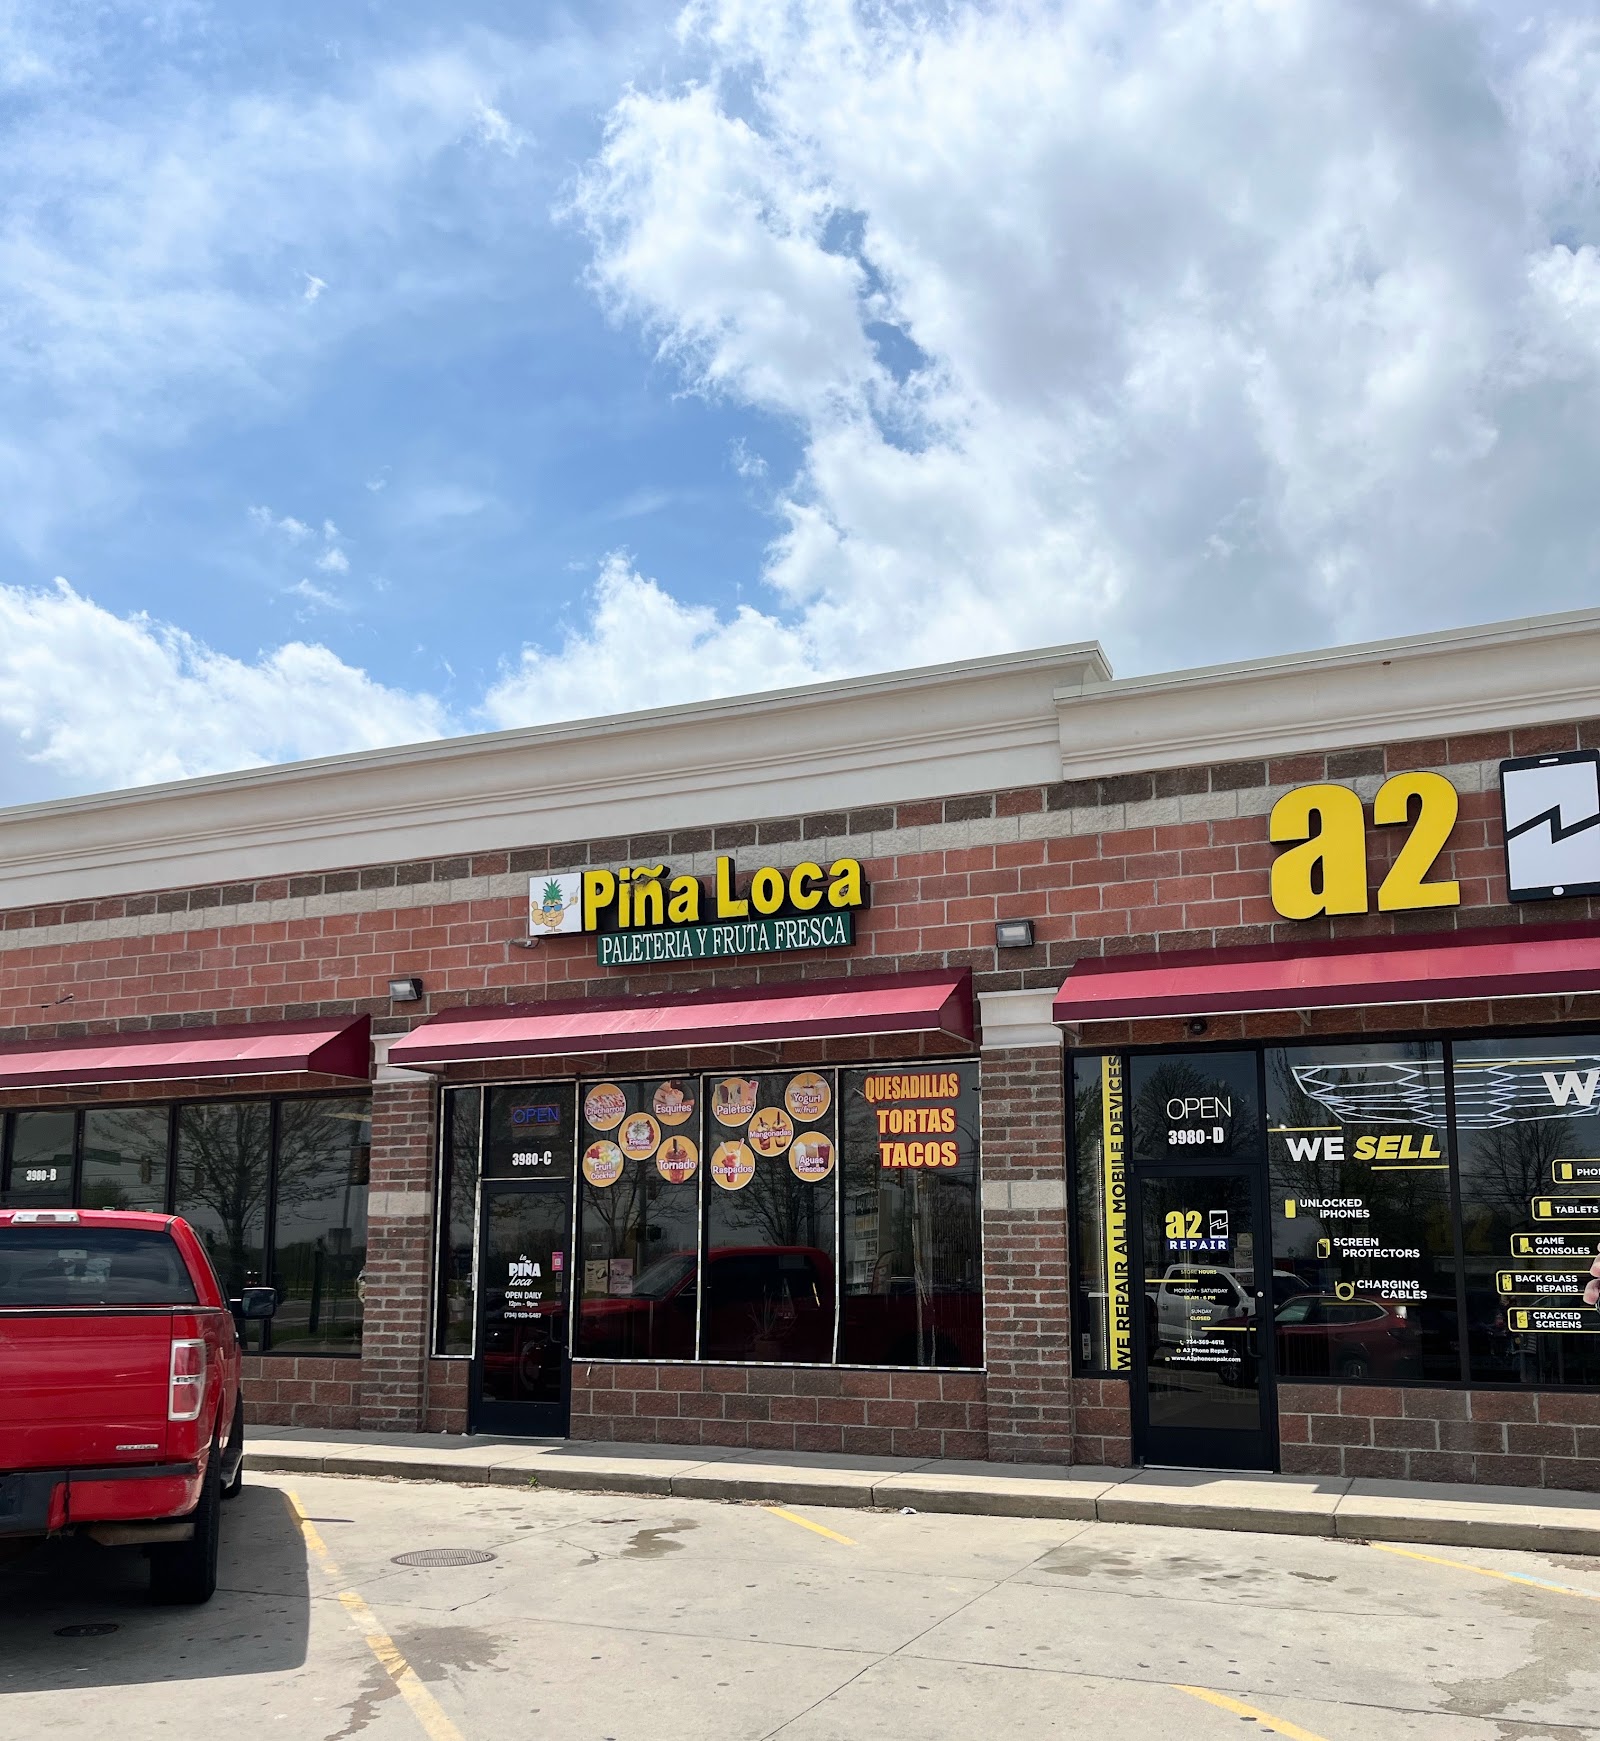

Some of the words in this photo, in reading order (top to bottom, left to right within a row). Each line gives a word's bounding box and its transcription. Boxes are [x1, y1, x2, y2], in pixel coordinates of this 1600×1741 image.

[1270, 771, 1460, 919] a2
[583, 864, 699, 931] Piña
[716, 856, 862, 919] Loca
[602, 933, 690, 964] PALETERIA
[698, 929, 711, 955] Y
[713, 923, 769, 953] FRUTA
[775, 915, 846, 950] FRESCA
[865, 1073, 959, 1102] QUESADILLAS
[793, 1093, 821, 1104] Yogurt
[1108, 1056, 1124, 1136] DEVICES
[655, 1104, 692, 1115] Esquites
[717, 1104, 752, 1116] Paletas
[1166, 1096, 1231, 1120] OPEN
[513, 1106, 559, 1123] OPEN
[877, 1108, 955, 1133] TORTAS
[750, 1129, 792, 1139] Mangonadas
[1168, 1126, 1224, 1145] 3980-D
[1286, 1137, 1345, 1161] WE
[1353, 1134, 1441, 1160] SELL
[512, 1150, 552, 1166] 3980-C
[880, 1142, 957, 1166] TACOS
[658, 1159, 697, 1170] Tornado
[800, 1155, 824, 1166] Aguas
[594, 1162, 612, 1171] Fruit
[713, 1163, 753, 1176] Raspados
[798, 1165, 825, 1173] Frescas
[26, 1168, 56, 1181] 3980-B
[591, 1171, 616, 1180] Cocktail
[1111, 1142, 1127, 1214] MOBILE
[1299, 1199, 1362, 1208] UNLOCKED
[1319, 1209, 1370, 1218] iPHONES
[1555, 1205, 1599, 1214] TABLETS
[1165, 1210, 1202, 1239] a2
[1113, 1219, 1128, 1257] ALL
[1333, 1238, 1379, 1246] SCREEN
[1535, 1237, 1564, 1245] GAME
[1169, 1240, 1226, 1250] REPAIR
[1535, 1246, 1590, 1255] CONSOLES
[1342, 1248, 1420, 1257] PROTECTORS
[508, 1260, 541, 1277] PIÑA
[509, 1274, 533, 1286] Loca
[1356, 1280, 1420, 1289] CHARGING
[1545, 1275, 1578, 1283] GLASS
[1381, 1290, 1428, 1299] CABLES
[1536, 1285, 1578, 1293] REPAIRS
[505, 1291, 523, 1299] OPEN
[524, 1291, 542, 1299] DAILY
[1115, 1261, 1130, 1330] REPAIR
[1533, 1311, 1581, 1319] CRACKED
[1535, 1320, 1582, 1329] SCREENS
[1117, 1338, 1131, 1370] WE
[1210, 1347, 1229, 1355] Repair
